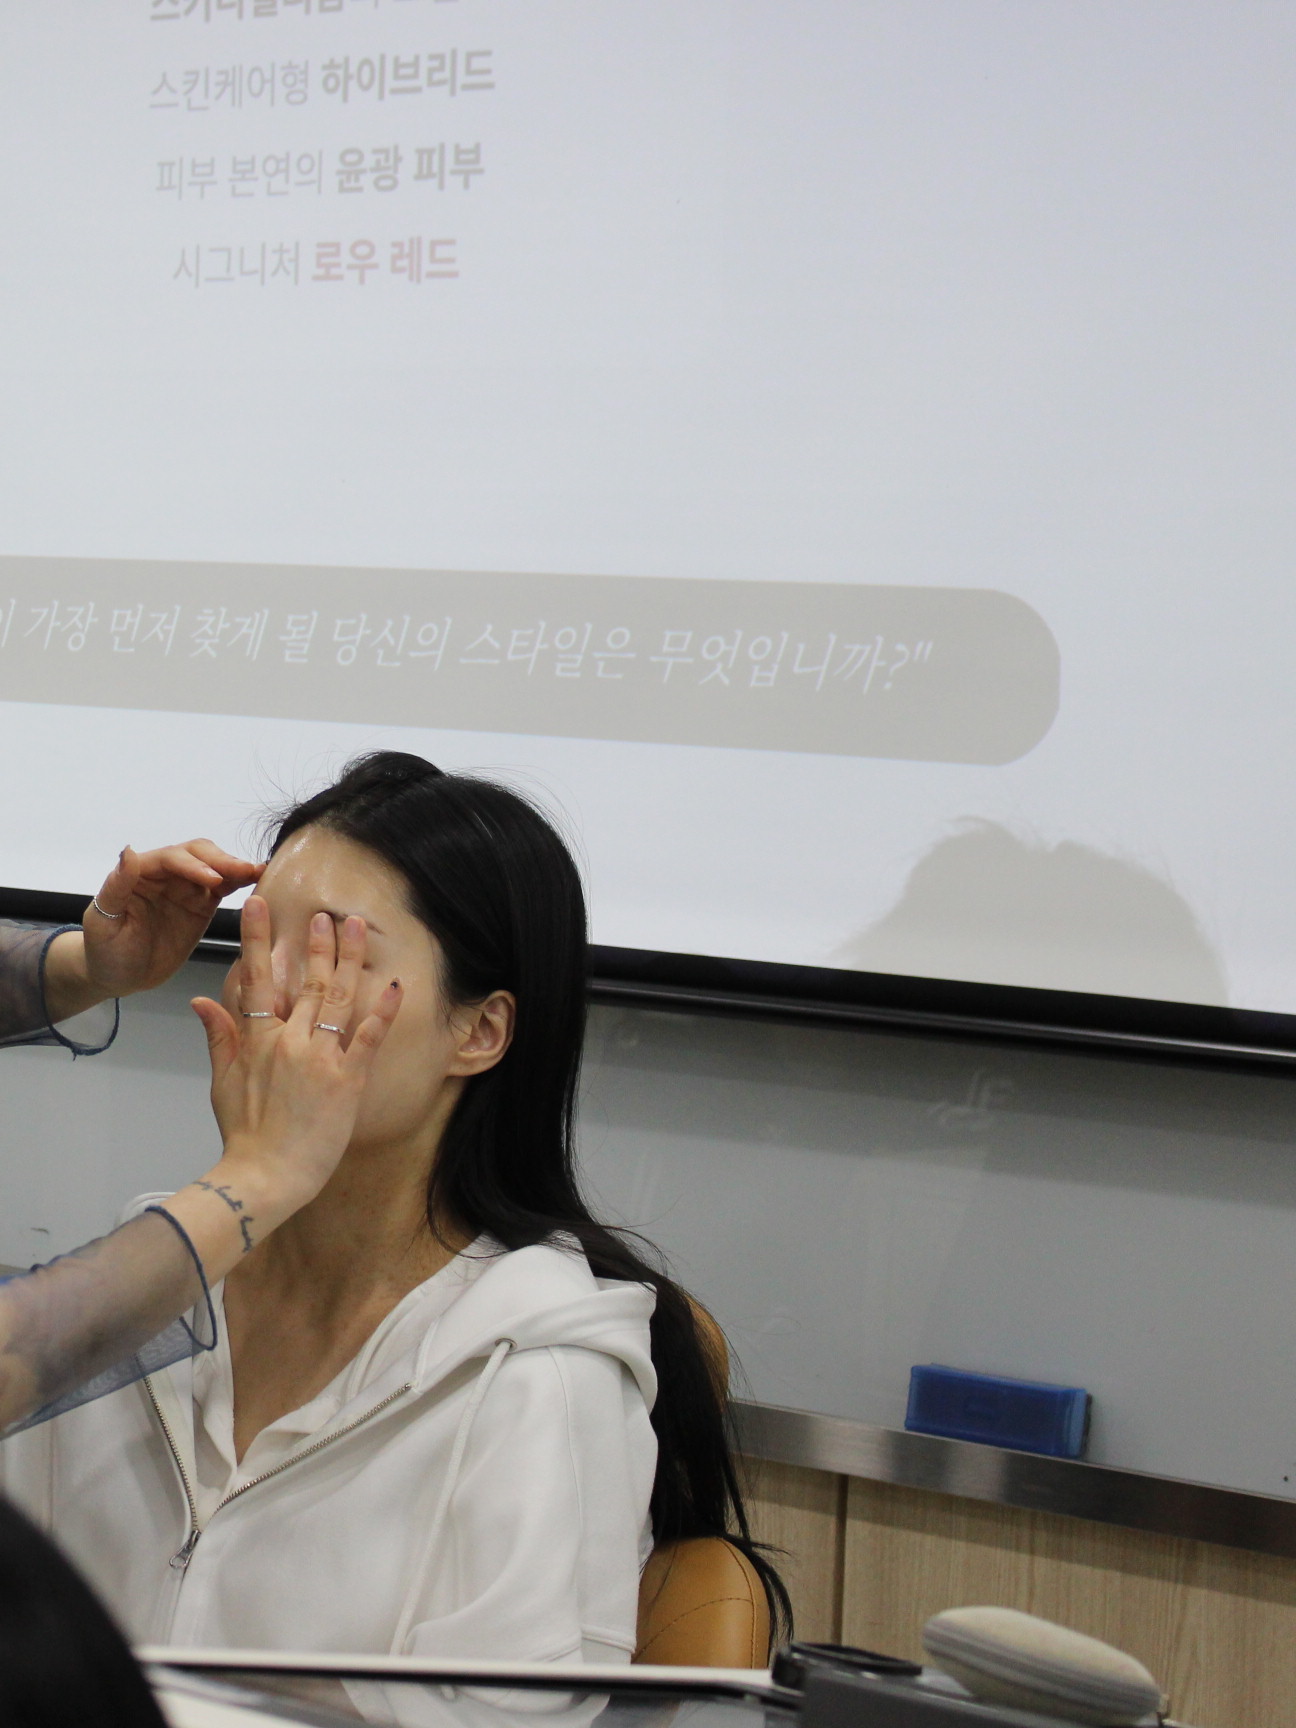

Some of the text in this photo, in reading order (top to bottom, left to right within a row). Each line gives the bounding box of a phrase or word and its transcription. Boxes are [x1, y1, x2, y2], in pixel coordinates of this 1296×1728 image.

[149, 48, 496, 112] 스킨케어형 하이브리드
[155, 142, 485, 200] 피부 본연의 윤광 피부
[173, 236, 460, 288] 시그니처 로우 레드
[23, 600, 99, 652] 가장
[109, 604, 182, 657] 먼저
[189, 607, 270, 661] 찾게
[278, 609, 319, 664] 될
[331, 613, 453, 672] 당신의
[459, 619, 638, 679] 스타일은
[649, 628, 934, 695] 무엇입니까?"
